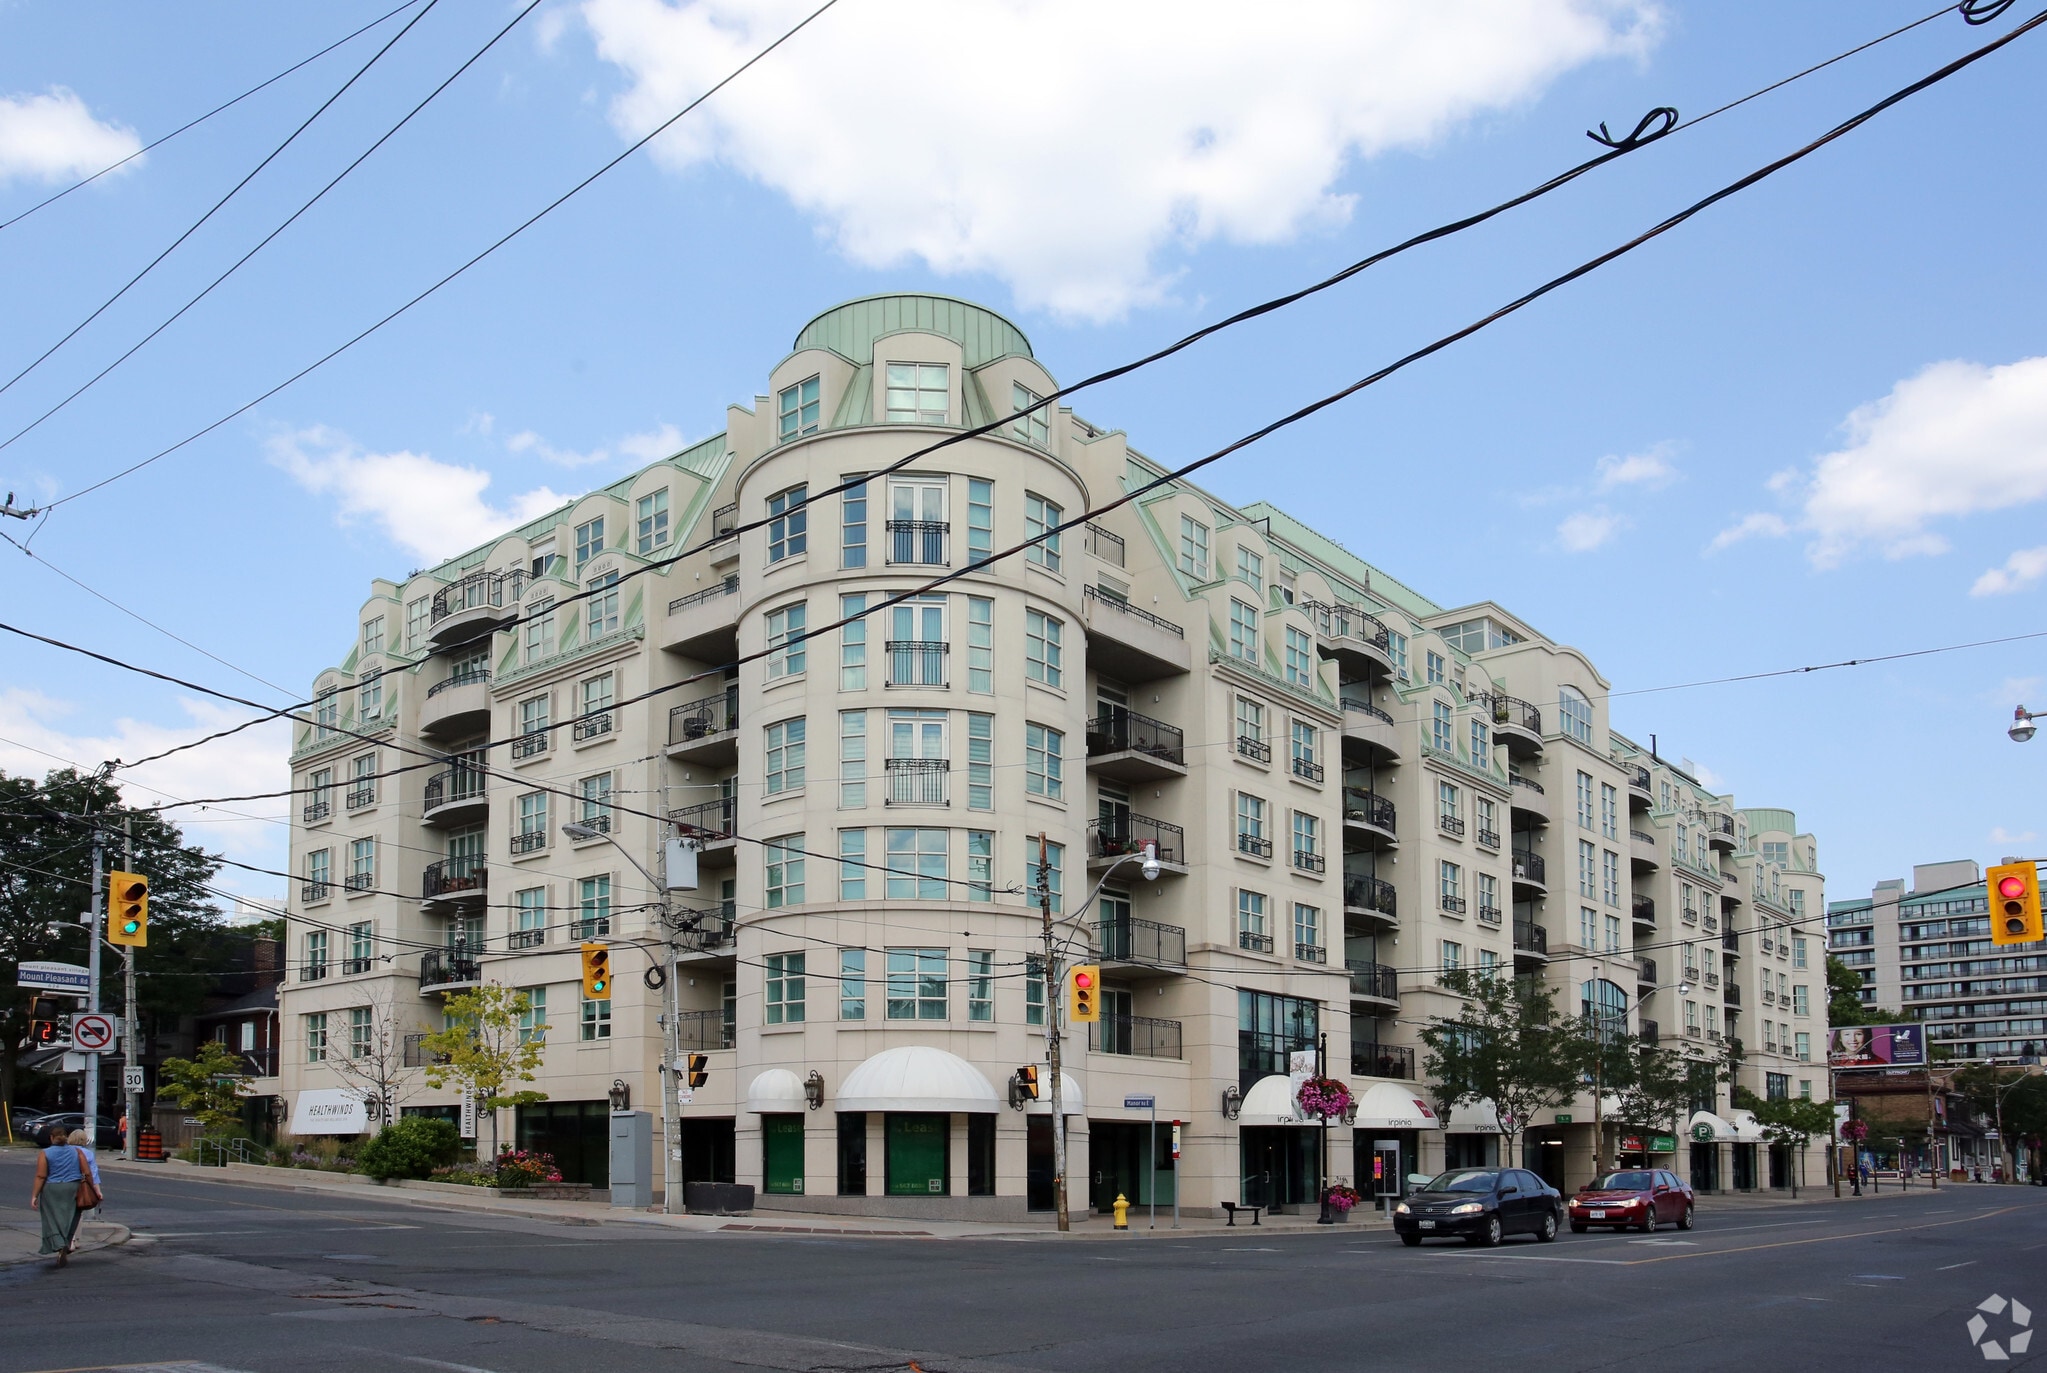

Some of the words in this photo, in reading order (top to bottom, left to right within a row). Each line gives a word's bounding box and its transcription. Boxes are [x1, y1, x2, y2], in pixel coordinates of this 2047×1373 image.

[41, 964, 67, 972] pleasant
[19, 971, 44, 981] Mount
[45, 973, 77, 984] Pleasant
[80, 977, 89, 985] Rd
[126, 1074, 142, 1085] 30
[308, 1103, 354, 1116] HEALTHWINDS
[904, 1121, 937, 1133] Leas
[1388, 1118, 1412, 1127] irpinia
[1474, 1124, 1497, 1133] irpinia
[1698, 1127, 1708, 1137] P
